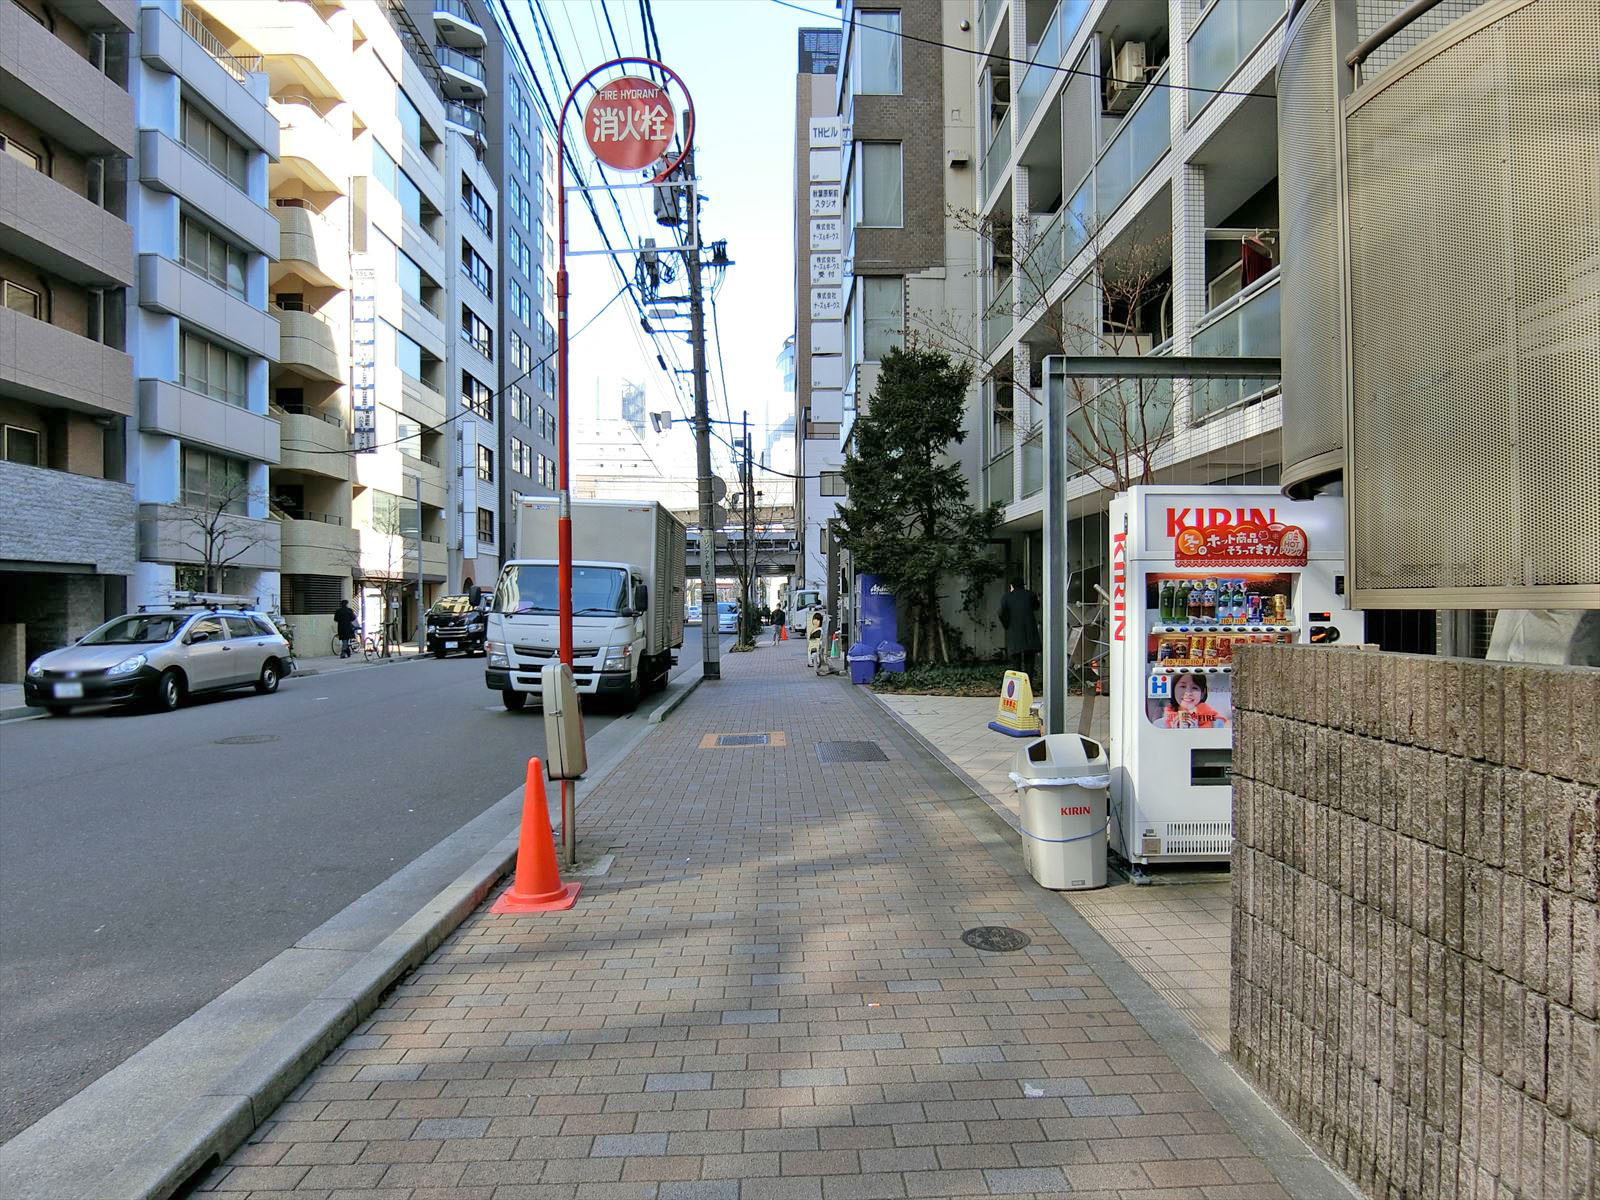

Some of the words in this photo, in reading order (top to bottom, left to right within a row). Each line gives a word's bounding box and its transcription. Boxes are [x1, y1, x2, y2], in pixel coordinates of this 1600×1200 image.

[599, 90, 618, 100] FIRE
[620, 88, 660, 100] HYDRANT
[592, 104, 669, 143] 消火栓
[812, 127, 839, 138] THビル
[815, 200, 837, 208] スタジオ
[816, 223, 836, 231] 株式会社
[816, 292, 837, 300] 株式会社
[1206, 531, 1259, 548] ホット商品
[1284, 540, 1300, 549] HOT
[1113, 532, 1126, 641] KIRIN
[1198, 714, 1216, 722] FIRE
[1060, 806, 1091, 816] KIRIN
